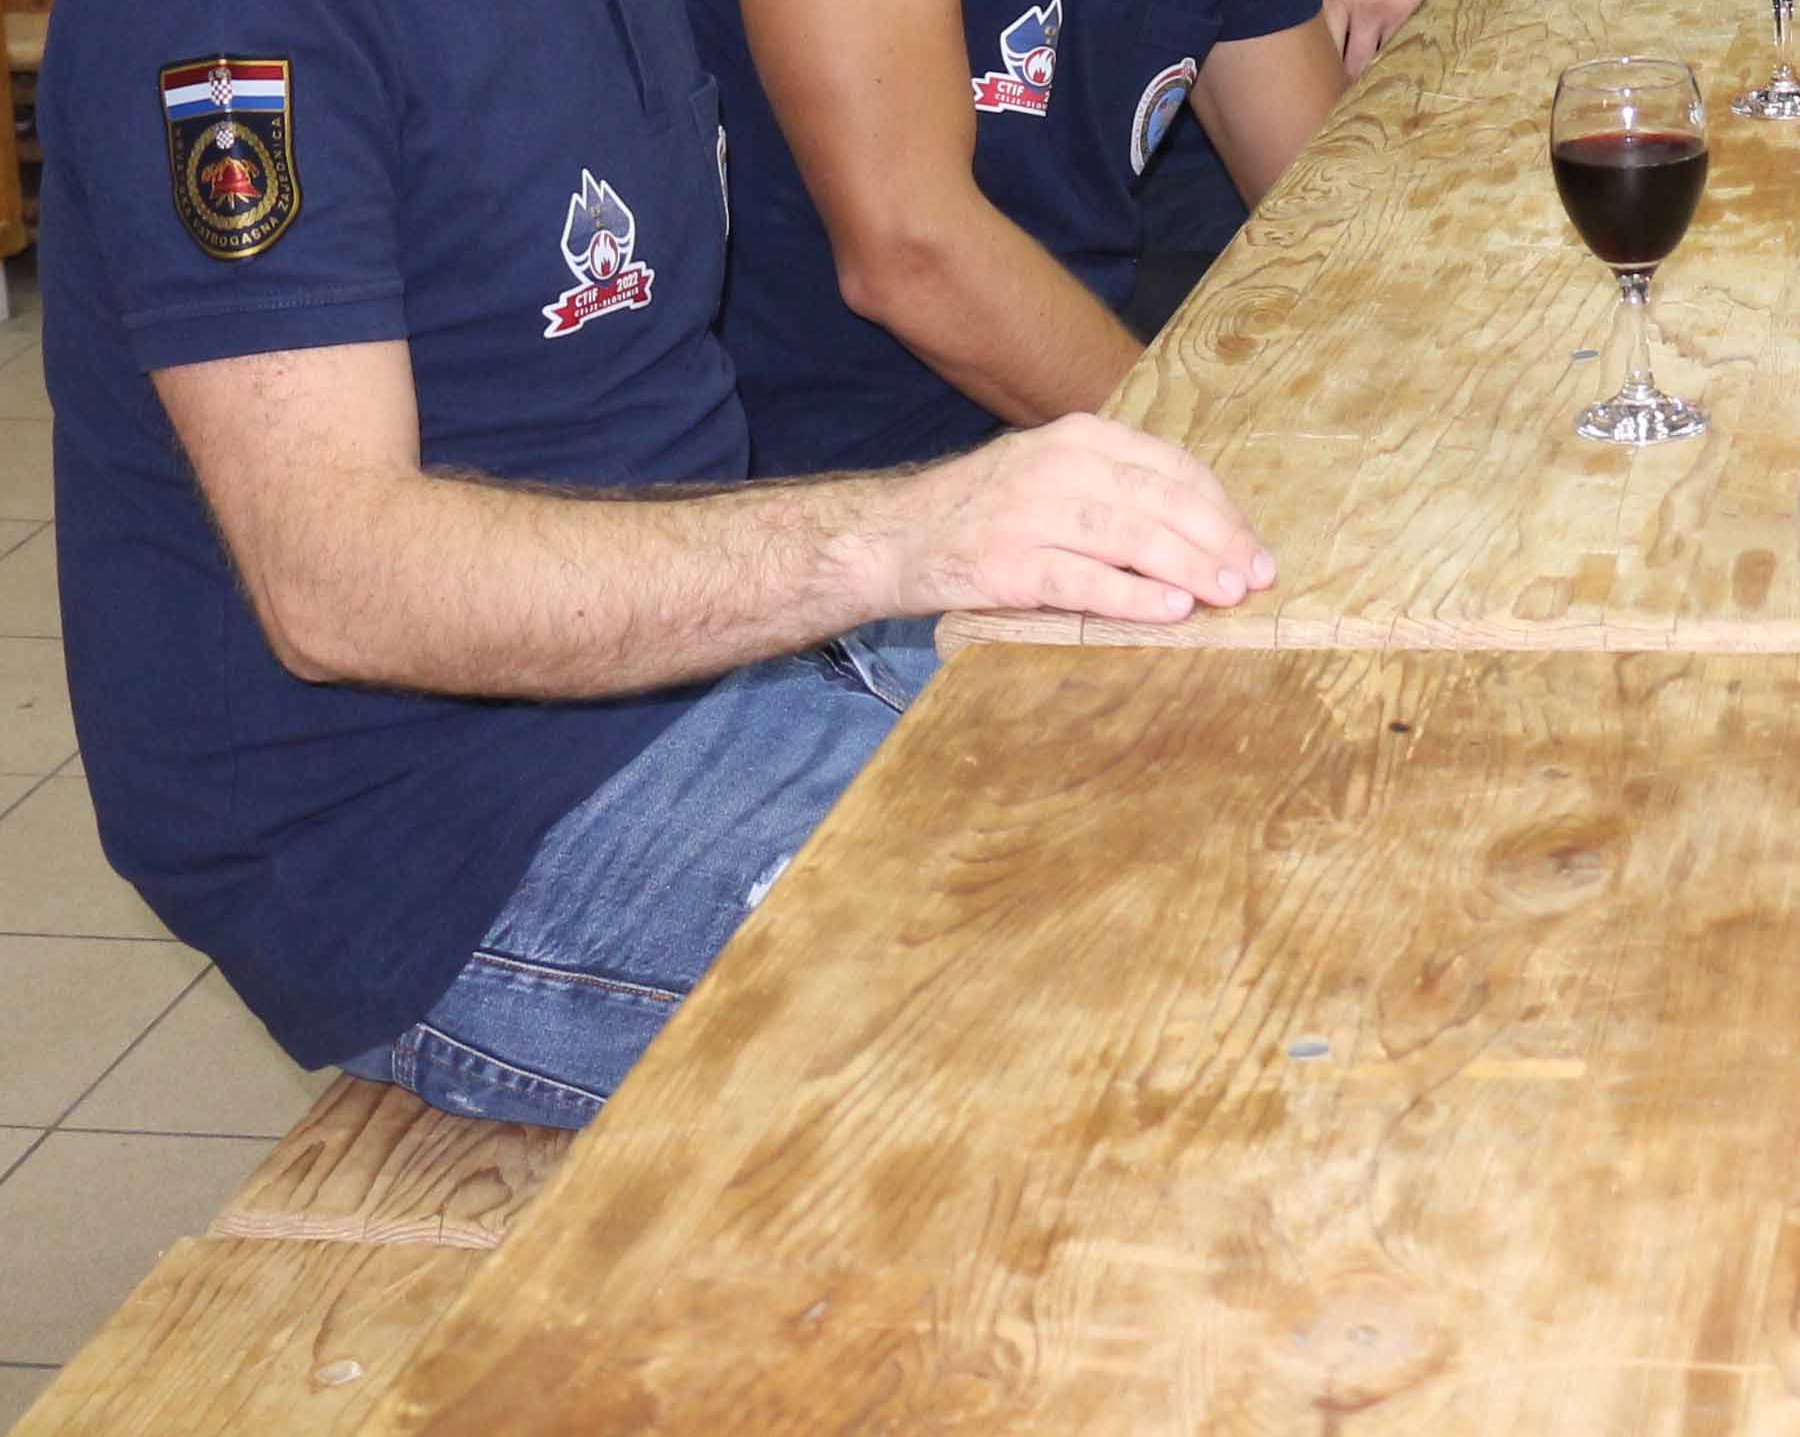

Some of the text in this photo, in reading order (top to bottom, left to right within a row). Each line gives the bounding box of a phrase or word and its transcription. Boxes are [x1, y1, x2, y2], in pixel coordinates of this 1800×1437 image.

[997, 81, 1025, 96] CTIF
[575, 272, 639, 308] CTIF 2022
